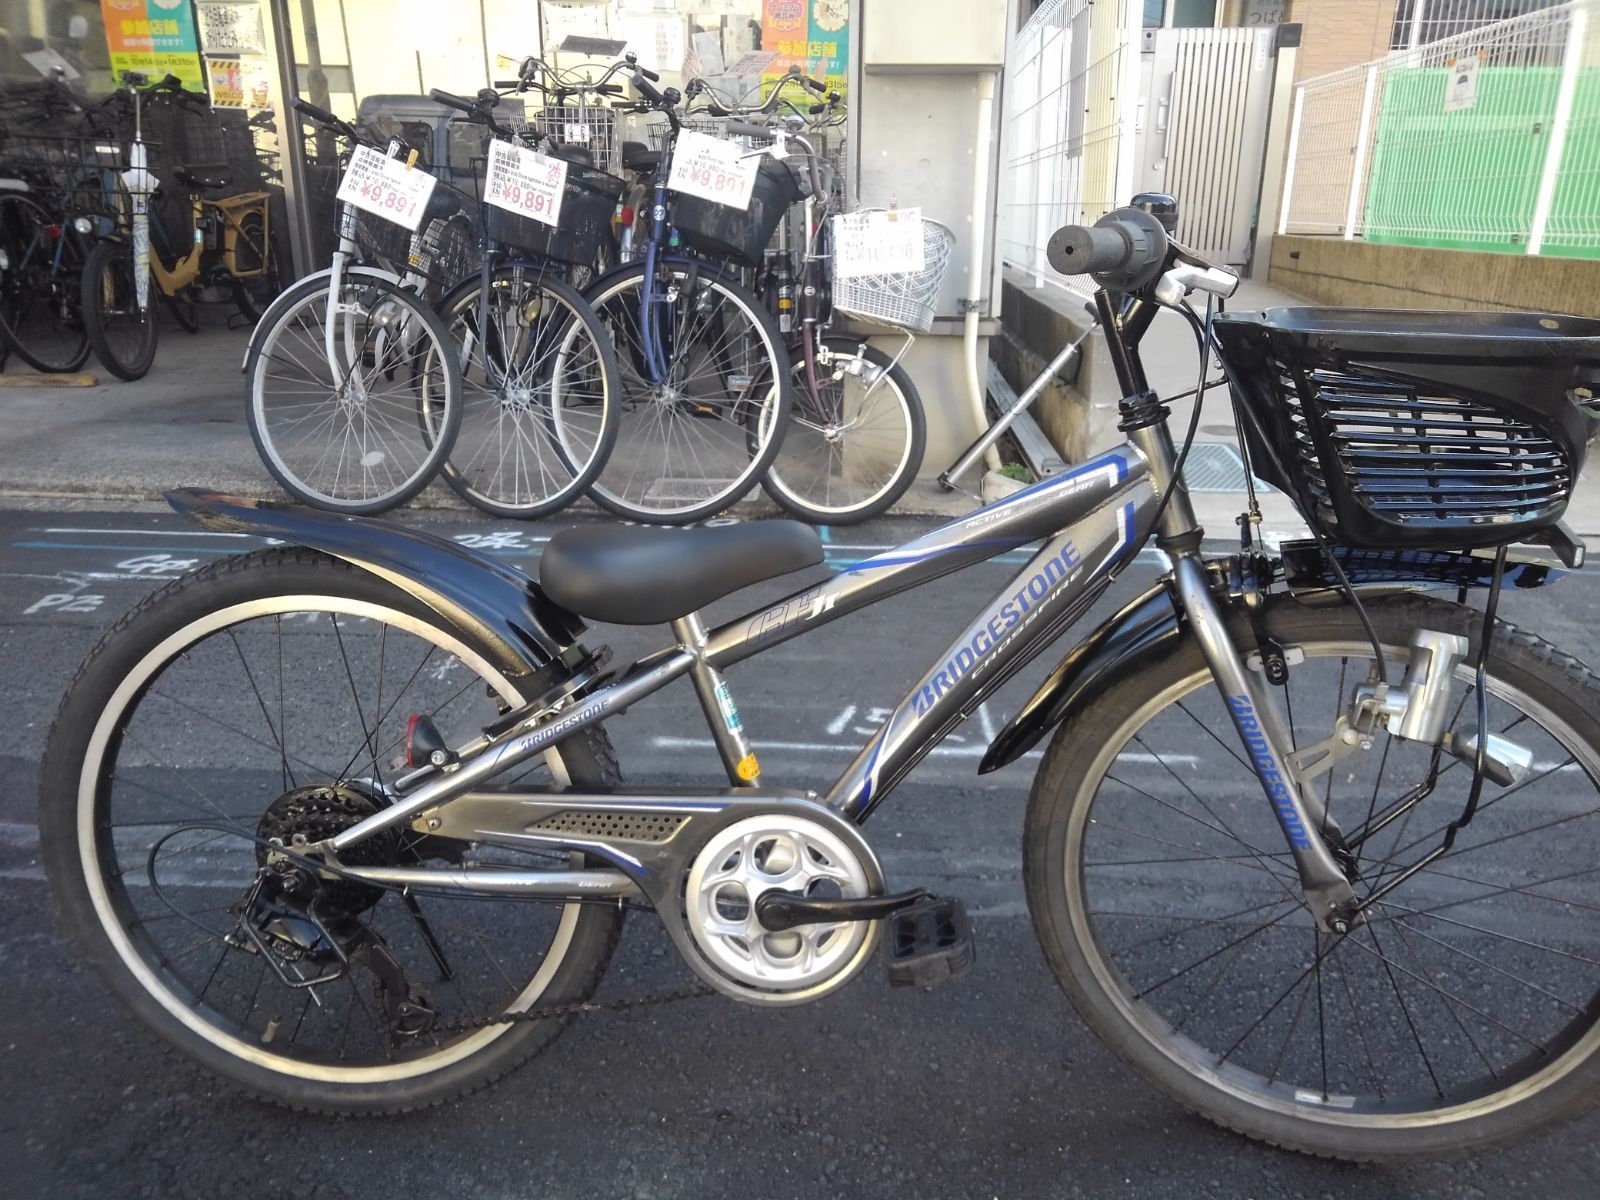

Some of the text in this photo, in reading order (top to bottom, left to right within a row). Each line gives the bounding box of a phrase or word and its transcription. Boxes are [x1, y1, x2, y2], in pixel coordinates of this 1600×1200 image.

[121, 18, 179, 36] 参加店舗
[777, 40, 837, 57] 参加店舗
[214, 90, 244, 99] welco
[360, 179, 417, 218] ¥9,891
[502, 182, 555, 216] ¥9,891
[965, 480, 1095, 530] ACTIVE GEAR
[911, 539, 1082, 721] BRIDGESTONE
[971, 565, 1084, 680] CROSSFIRE
[519, 699, 609, 752] BRIDGESTONE
[1229, 694, 1314, 851] BRIDGESTONE
